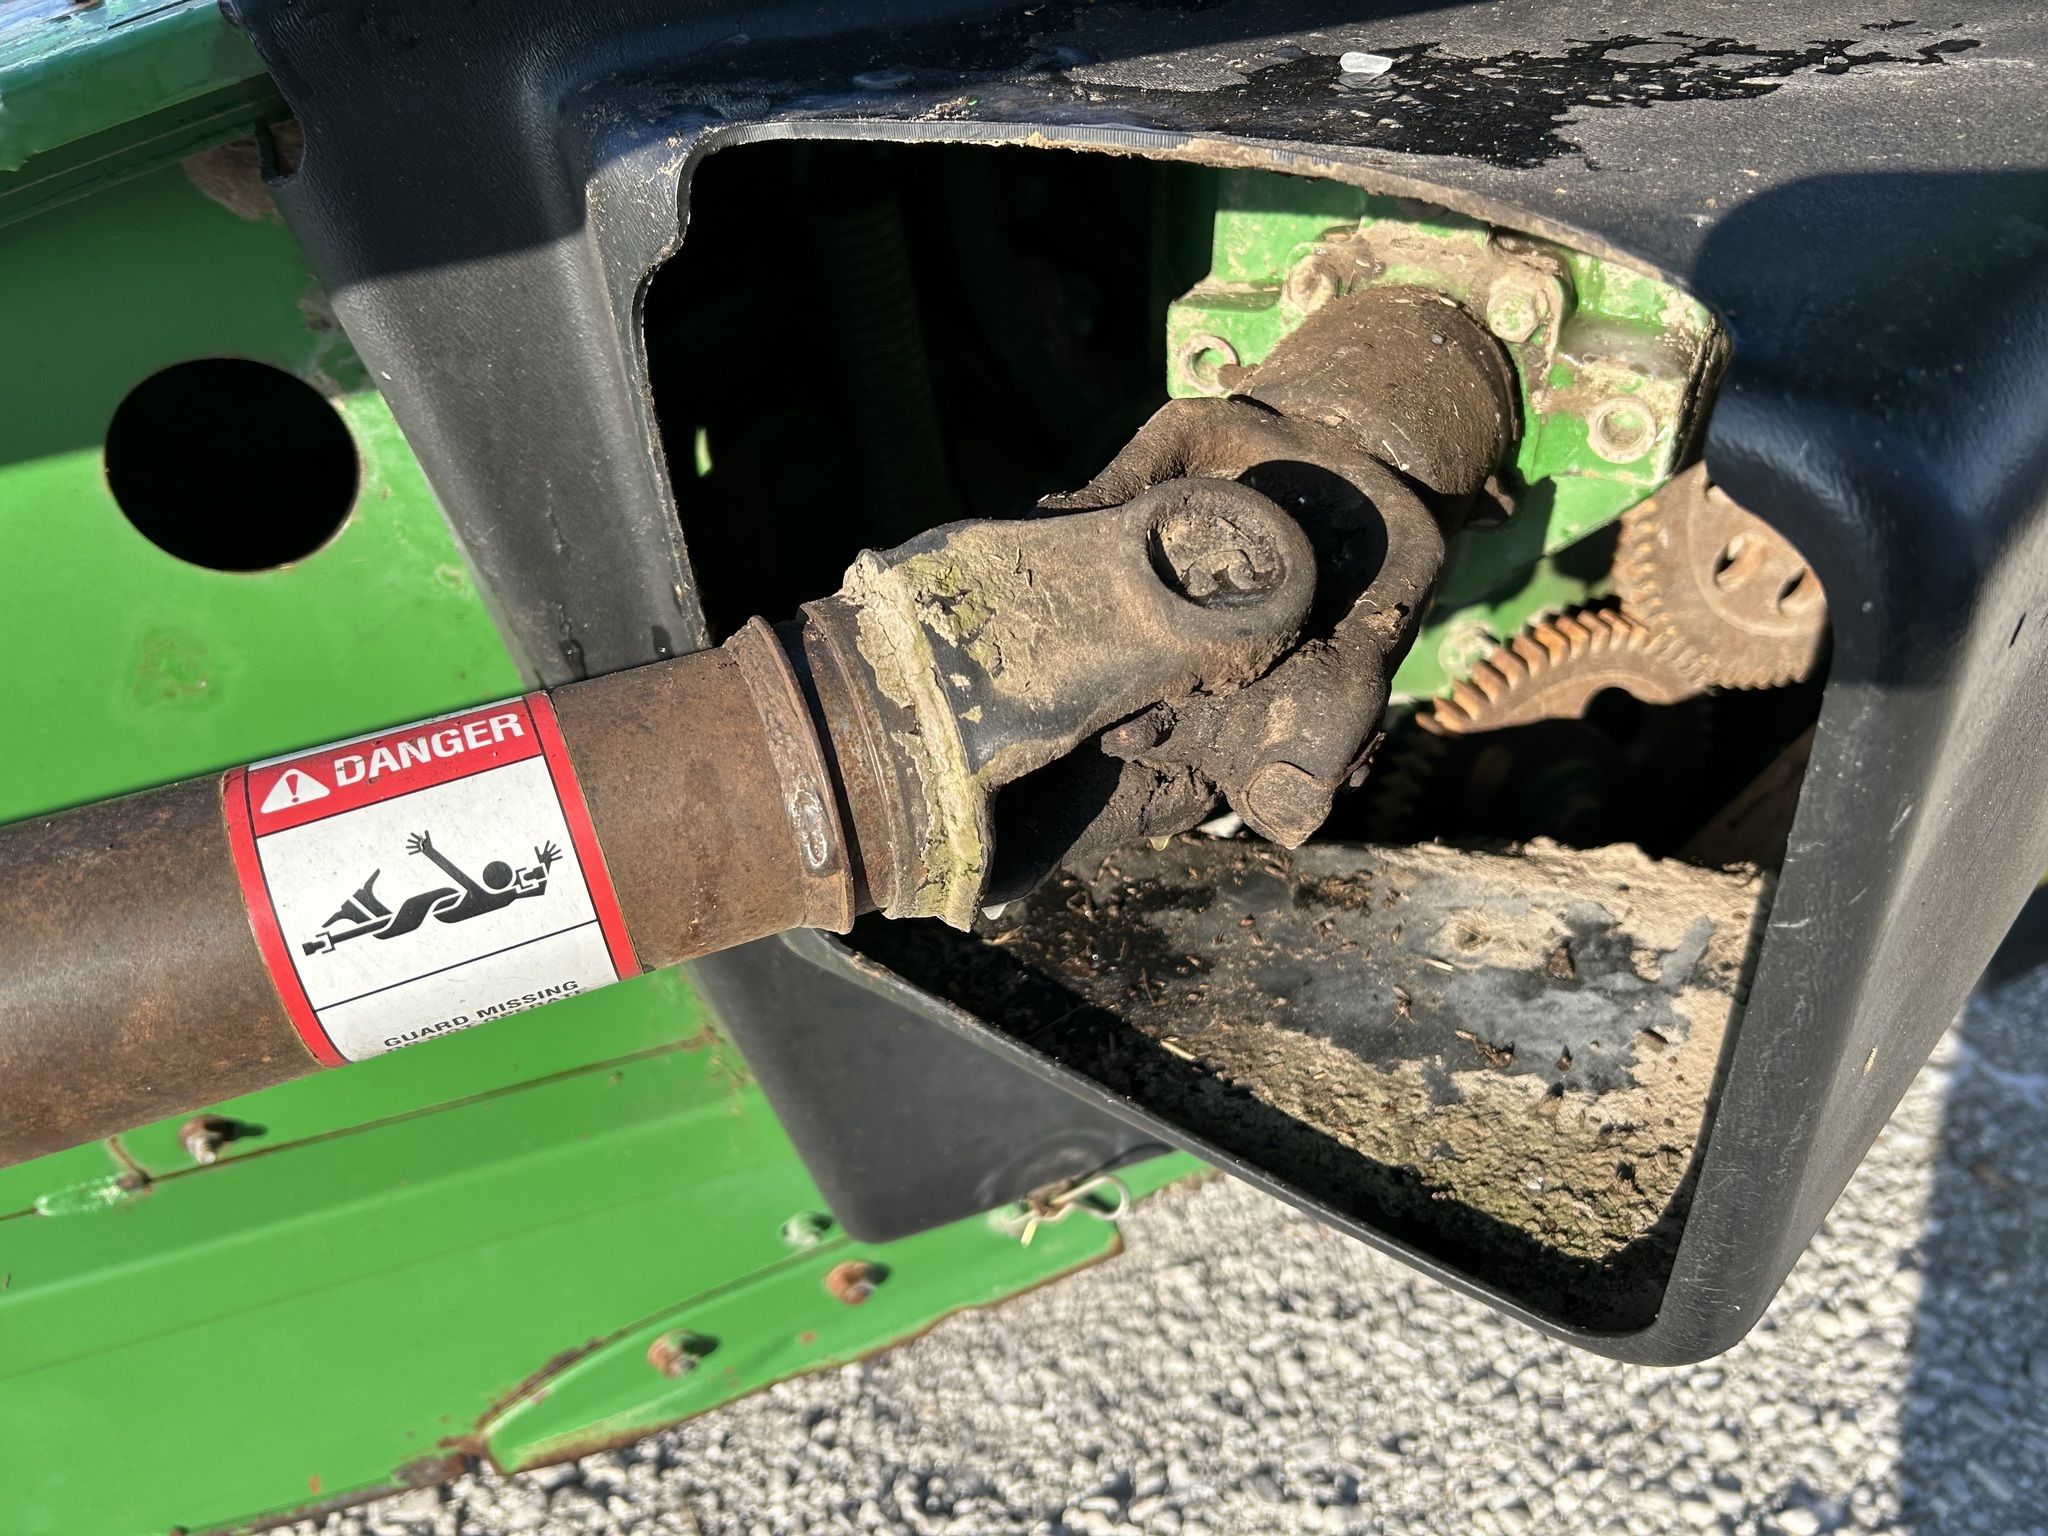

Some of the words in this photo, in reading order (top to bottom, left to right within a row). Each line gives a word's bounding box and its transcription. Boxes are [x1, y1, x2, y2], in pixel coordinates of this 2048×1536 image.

[333, 713, 525, 787] DANGER
[384, 1015, 469, 1047] GUARD
[476, 980, 579, 1018] MISSING
